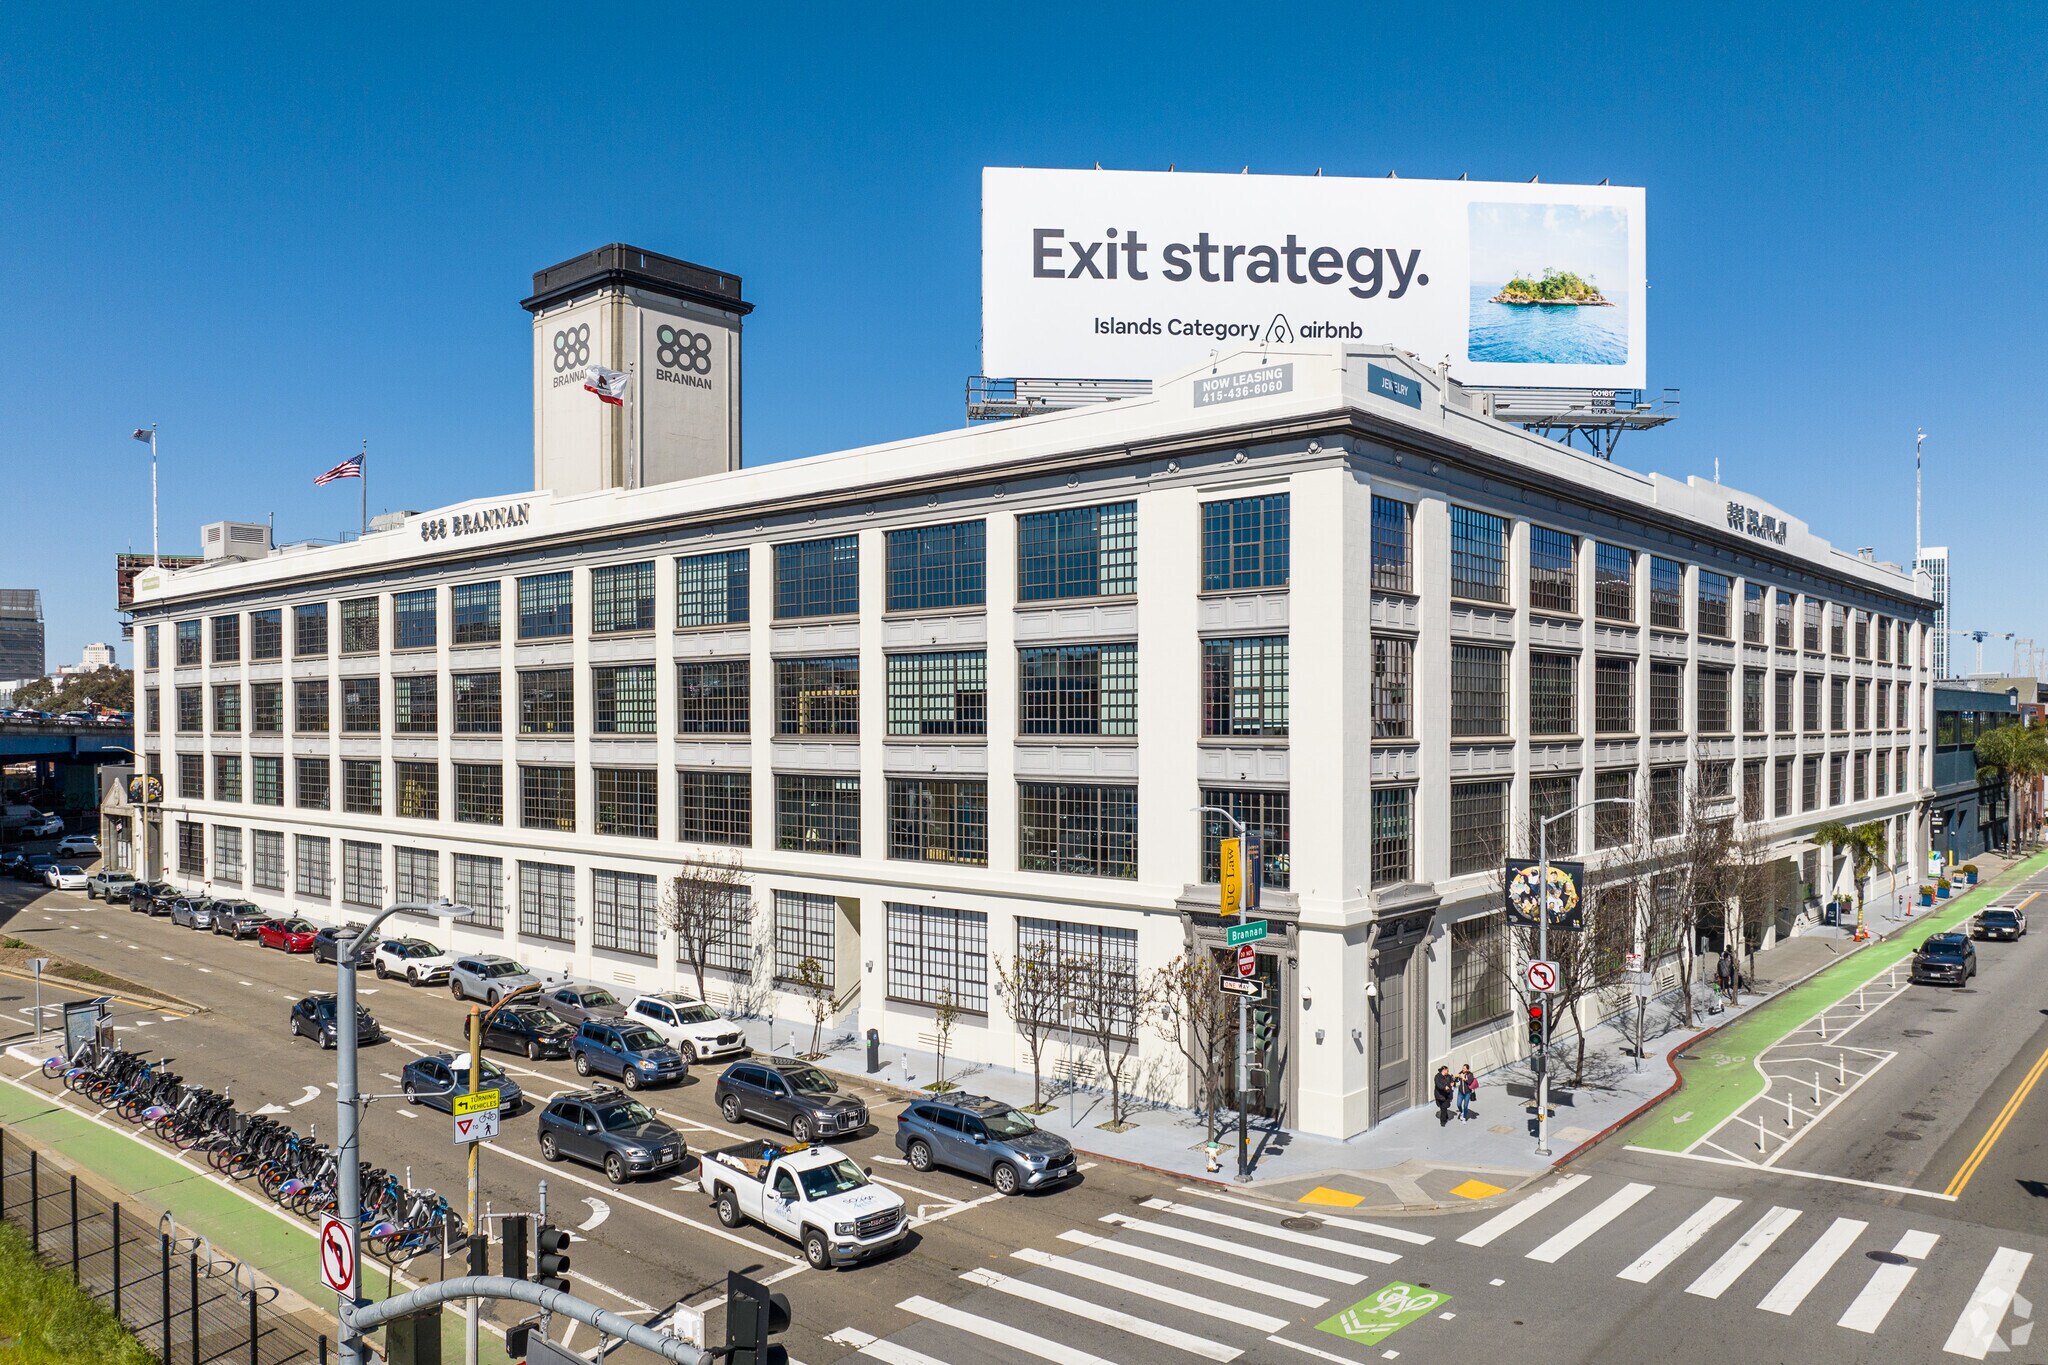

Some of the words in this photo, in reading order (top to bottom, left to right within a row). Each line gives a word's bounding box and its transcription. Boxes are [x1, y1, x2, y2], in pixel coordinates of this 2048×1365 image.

[1033, 227, 1148, 281] Exit
[1162, 232, 1429, 299] strategy.
[1094, 316, 1162, 336] Islands
[1167, 318, 1260, 342] Category
[1300, 321, 1363, 339] airbnb
[554, 323, 590, 373] 888
[657, 324, 712, 375] 888
[656, 368, 712, 390] BRANNAN
[1202, 377, 1231, 392] NOW
[1233, 368, 1283, 386] LEASING
[1381, 377, 1410, 397] JEWELRY
[1202, 380, 1283, 403] 415-436-6060
[421, 519, 447, 541] 888
[452, 503, 530, 535] BRANNAN
[1227, 848, 1236, 876] Law
[1227, 884, 1236, 907] UC
[1231, 926, 1263, 941] Brannan
[1225, 981, 1236, 989] ONE
[470, 1101, 496, 1110] VEHICLES
[471, 1093, 496, 1102] TURNING
